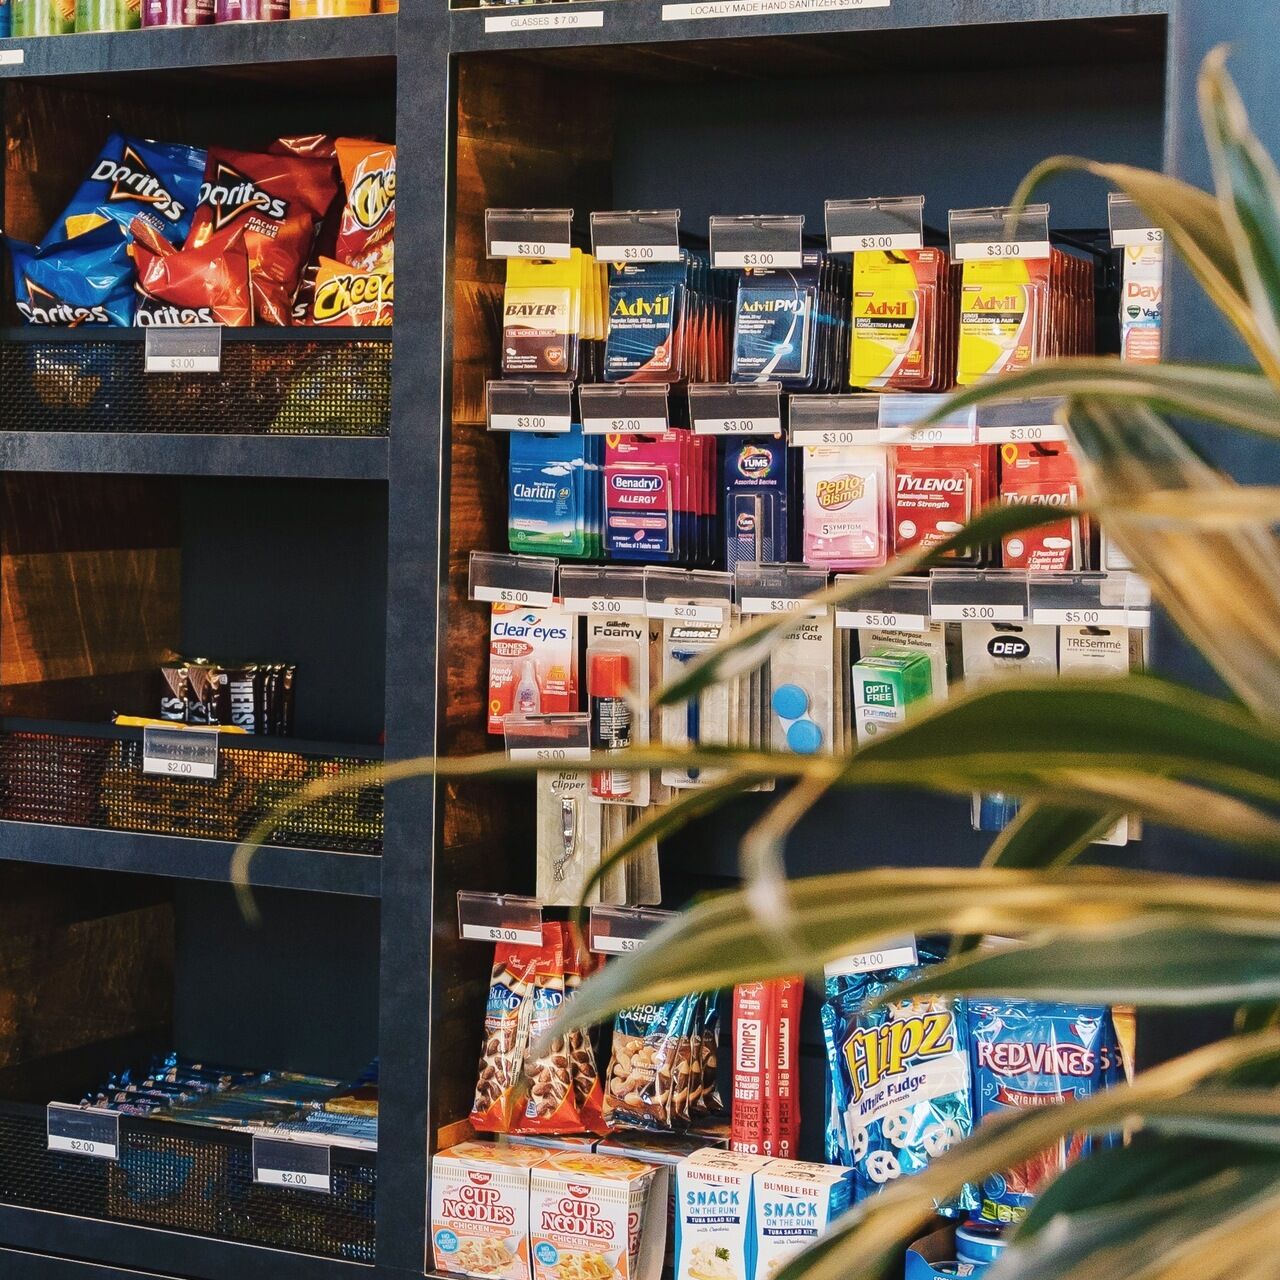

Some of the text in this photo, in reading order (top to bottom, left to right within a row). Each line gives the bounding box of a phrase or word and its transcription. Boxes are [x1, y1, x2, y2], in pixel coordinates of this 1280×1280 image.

[690, 6, 731, 15] LOCALLY
[732, 3, 760, 13] MADE
[761, 1, 787, 11] HAND
[510, 17, 549, 27] GLASSES
[90, 159, 185, 221] Doritos
[199, 182, 286, 218] Doritos
[248, 216, 279, 232] NACHO
[861, 237, 892, 248] $3.00
[518, 244, 545, 255] $3.00
[624, 248, 653, 259] $3.00
[987, 245, 1019, 256] $3.00
[744, 254, 774, 265] $3.00
[612, 295, 669, 316] Advil
[740, 299, 798, 313] Advil PM
[864, 301, 907, 316] Advil
[971, 295, 1017, 310] Advil
[505, 304, 557, 316] BAYER
[169, 358, 195, 369] $3.00
[517, 417, 546, 428] $3.00
[611, 420, 640, 431] $2.00
[723, 420, 754, 432] $3.00
[822, 433, 853, 443] $3.00
[911, 430, 942, 442] $3.00
[1009, 428, 1042, 440] $3.00
[743, 458, 768, 467] TUMS
[615, 477, 659, 490] Benadryl
[897, 474, 965, 492] TYLENOL
[513, 484, 555, 499] Claritin
[822, 487, 863, 505] Bismol
[618, 495, 657, 504] ALLERGY
[897, 500, 949, 509] Extra Strength
[822, 525, 829, 535] 5
[501, 590, 528, 602] $5.00
[591, 601, 621, 612] $3.00
[674, 607, 697, 616] $2.00
[770, 600, 801, 611] $3.00
[962, 606, 995, 618] $3.00
[1065, 611, 1099, 623] $5.00
[866, 615, 896, 626] $5.00
[493, 622, 567, 642] Clear eyes
[593, 626, 642, 639] Foamy
[673, 628, 720, 638] Sensor2
[802, 632, 822, 642] Case
[492, 642, 528, 651] REDNESS
[907, 639, 932, 648] Solution
[993, 643, 1025, 654] DEP
[1067, 638, 1121, 649] TRESemmé
[496, 648, 522, 656] RELIEF
[491, 667, 513, 675] Handy
[491, 674, 513, 682] Pocket
[865, 685, 891, 694] OPTI-
[866, 692, 892, 702] FREE
[537, 749, 565, 760] $3.00
[167, 762, 192, 774] $2.00
[558, 772, 578, 780] Nail
[551, 780, 585, 789] Clipper
[489, 929, 517, 941] $3.00
[852, 954, 884, 967] $4.00
[620, 1010, 668, 1025] CASHEWS
[741, 1023, 757, 1069] CHOMPS
[1023, 1043, 1095, 1075] VINES
[887, 1073, 928, 1101] Fudge
[735, 1088, 754, 1099] BEEF
[1008, 1092, 1048, 1106] ORIGINAL
[70, 1141, 95, 1152] $2.00
[733, 1142, 758, 1153] ZERO
[281, 1173, 307, 1185] $2.00
[470, 1173, 490, 1181] NISSIN
[687, 1171, 741, 1185] BUMBLE BEE
[459, 1185, 500, 1205] CUP
[764, 1182, 818, 1196] BUMBLE BEE
[687, 1190, 740, 1205] SNACK
[442, 1199, 515, 1225] NOODLES
[559, 1198, 600, 1218] CUP
[763, 1202, 817, 1217] SNACK
[453, 1222, 490, 1233] CHICKEN
[541, 1212, 614, 1239] NOODLES
[767, 1218, 815, 1226] ON THE RUN!
[552, 1234, 589, 1246] CHICKEN
